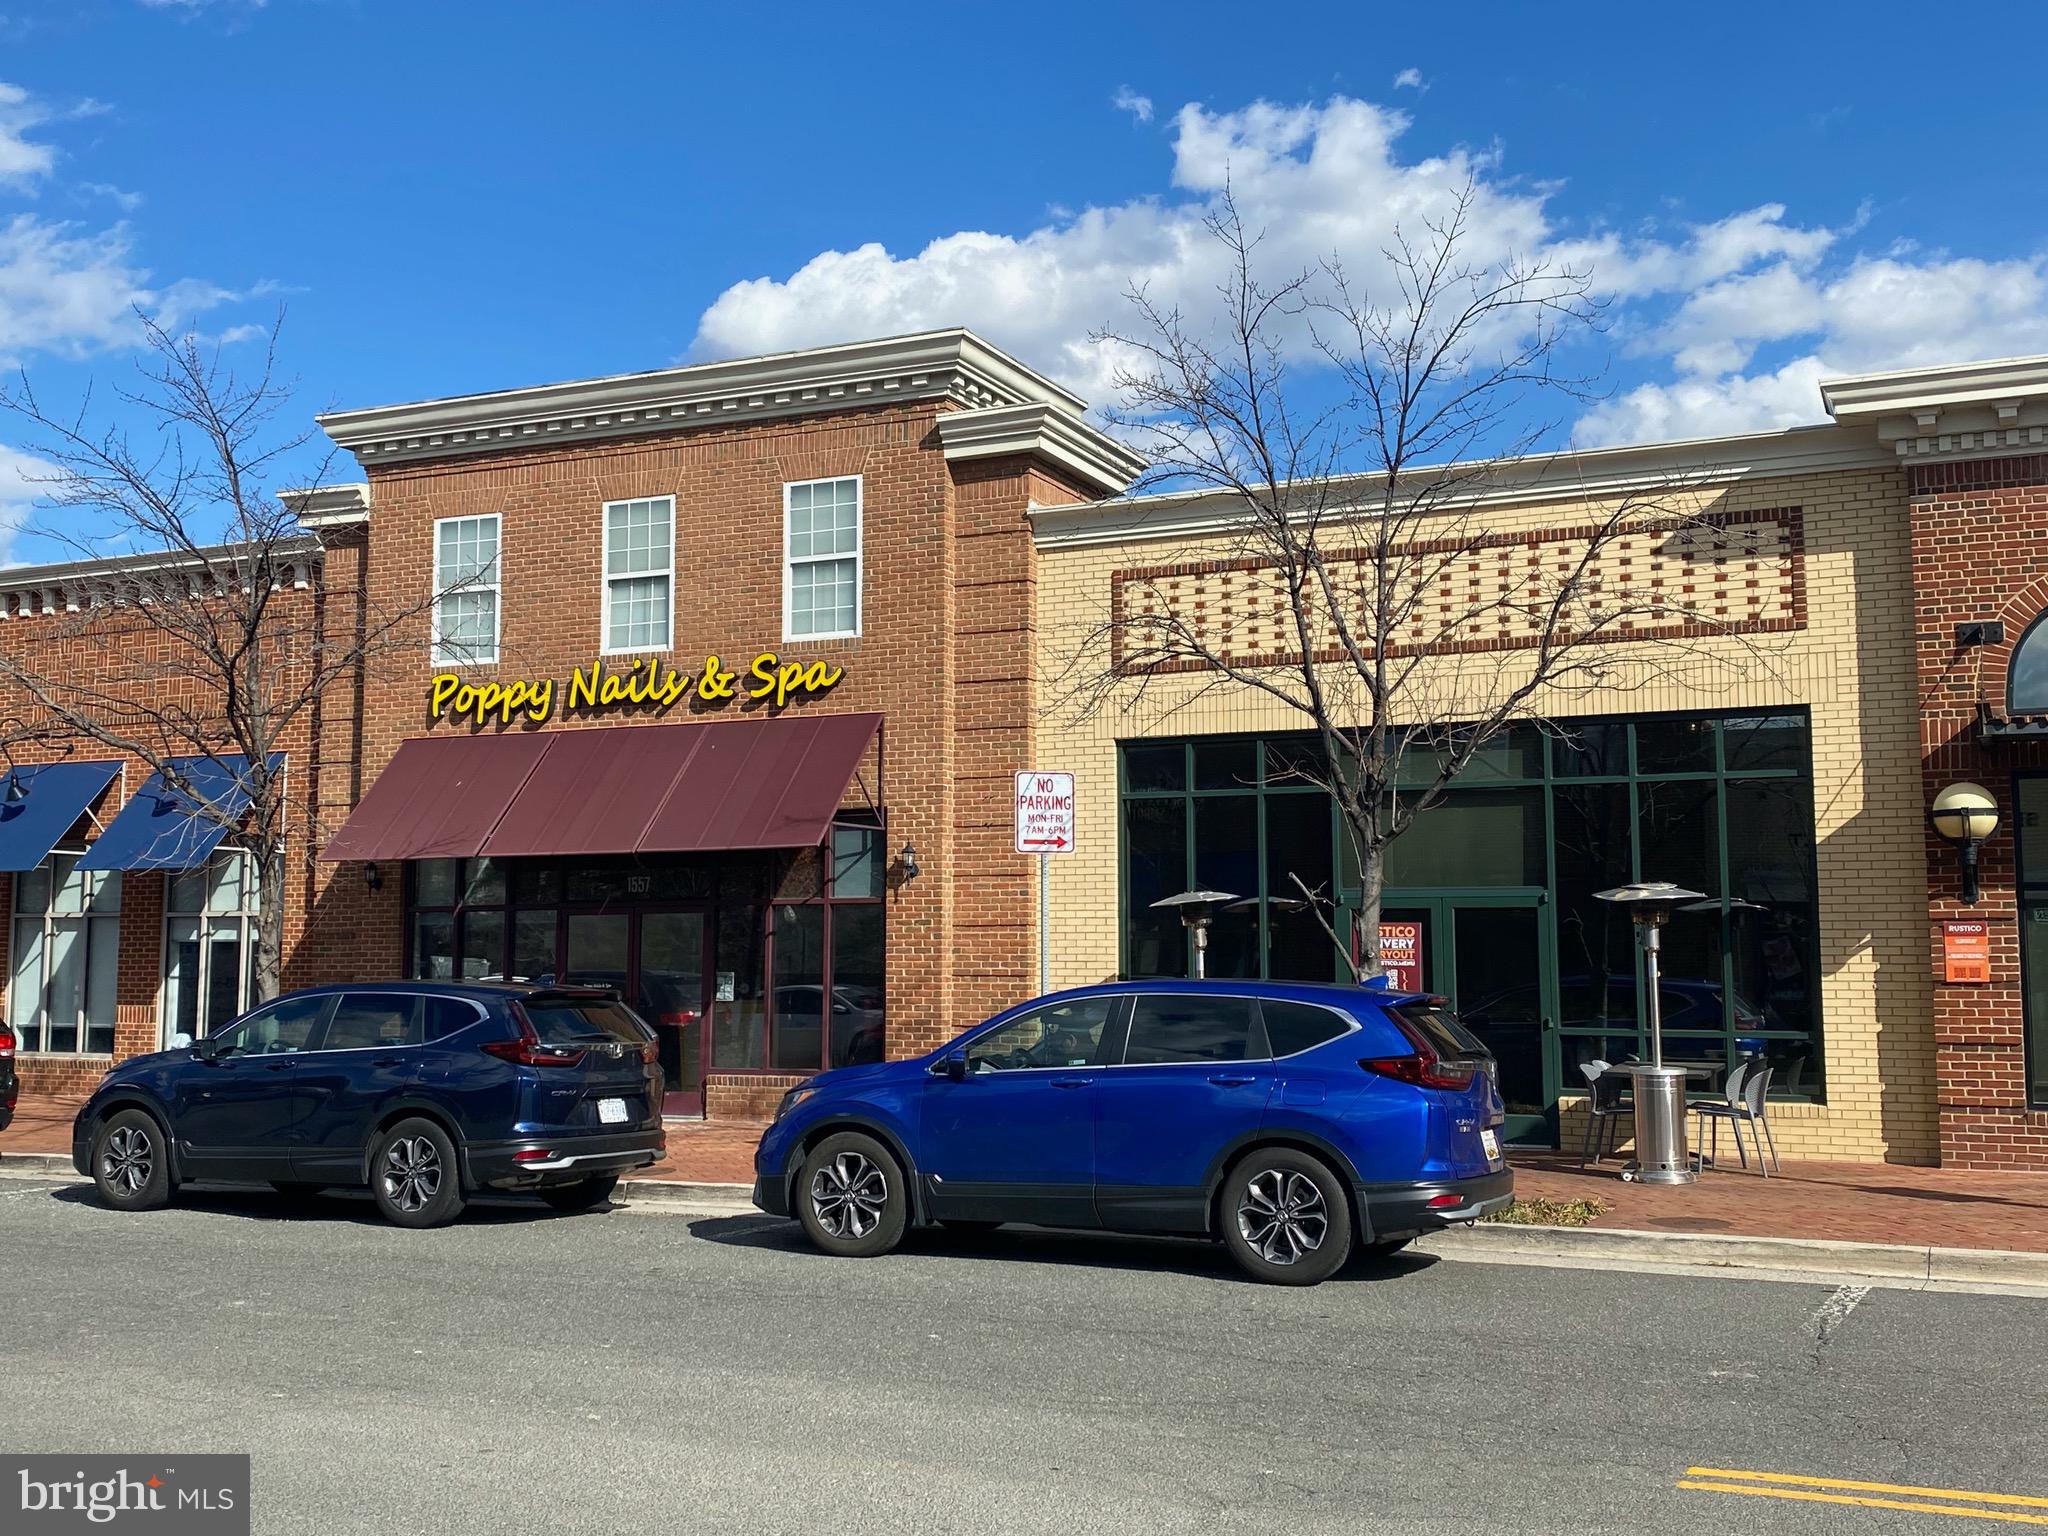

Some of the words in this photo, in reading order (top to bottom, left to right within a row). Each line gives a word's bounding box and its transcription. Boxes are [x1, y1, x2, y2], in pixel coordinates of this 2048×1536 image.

[431, 673, 552, 724] Poppy
[569, 657, 689, 709] Nails
[699, 655, 735, 699] &
[750, 652, 843, 706] Spa
[1037, 778, 1054, 793] NO
[1020, 795, 1071, 810] PARKING
[1027, 814, 1064, 823] MON-FRI
[1025, 826, 1066, 835] 7AM-6PM
[627, 876, 651, 893] 1557
[1379, 926, 1415, 937] STICO
[1380, 938, 1415, 949] IVERY
[1380, 950, 1415, 959] RYOUT
